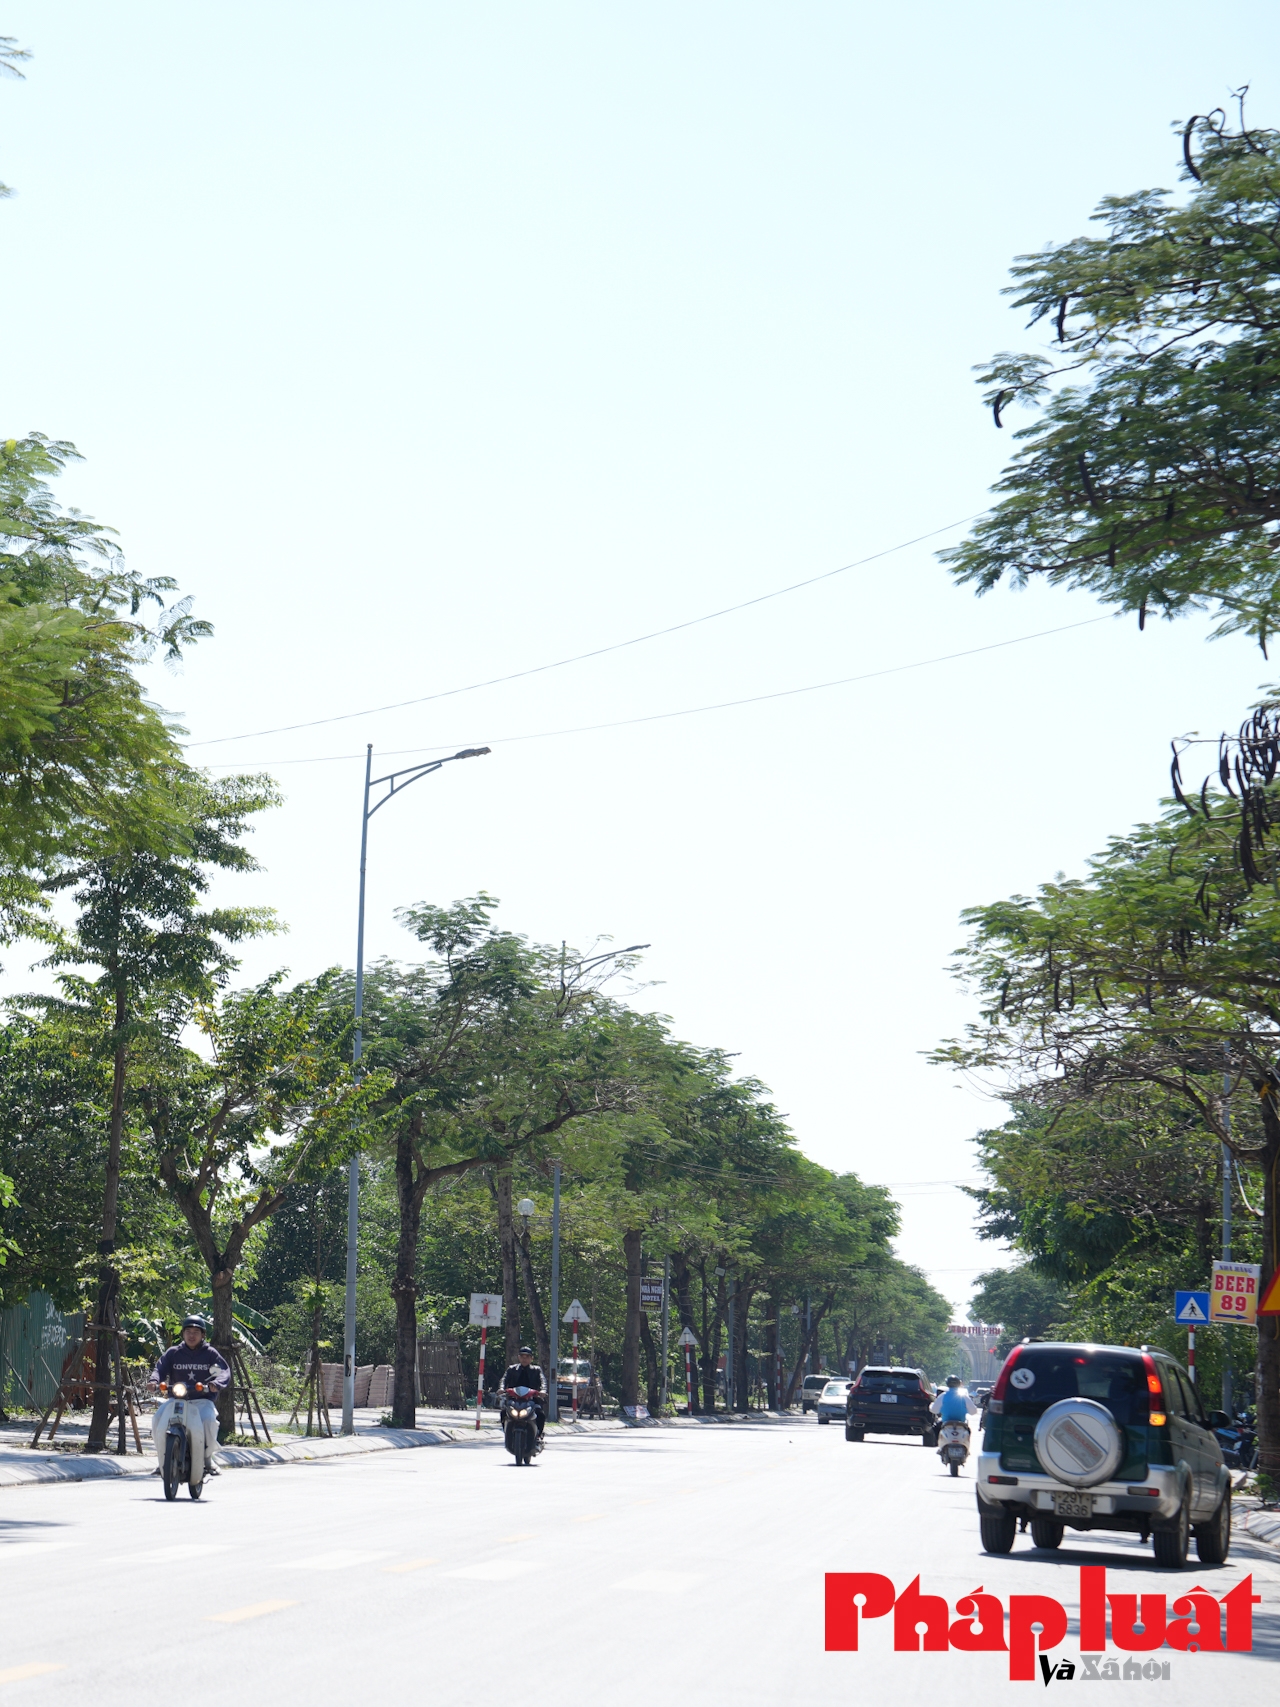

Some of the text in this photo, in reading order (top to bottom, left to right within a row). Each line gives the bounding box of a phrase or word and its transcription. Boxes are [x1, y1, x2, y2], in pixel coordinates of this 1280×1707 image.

[1214, 1274, 1256, 1293] BEER
[1221, 1294, 1247, 1312] 89
[1058, 1503, 1088, 1516] 5836
